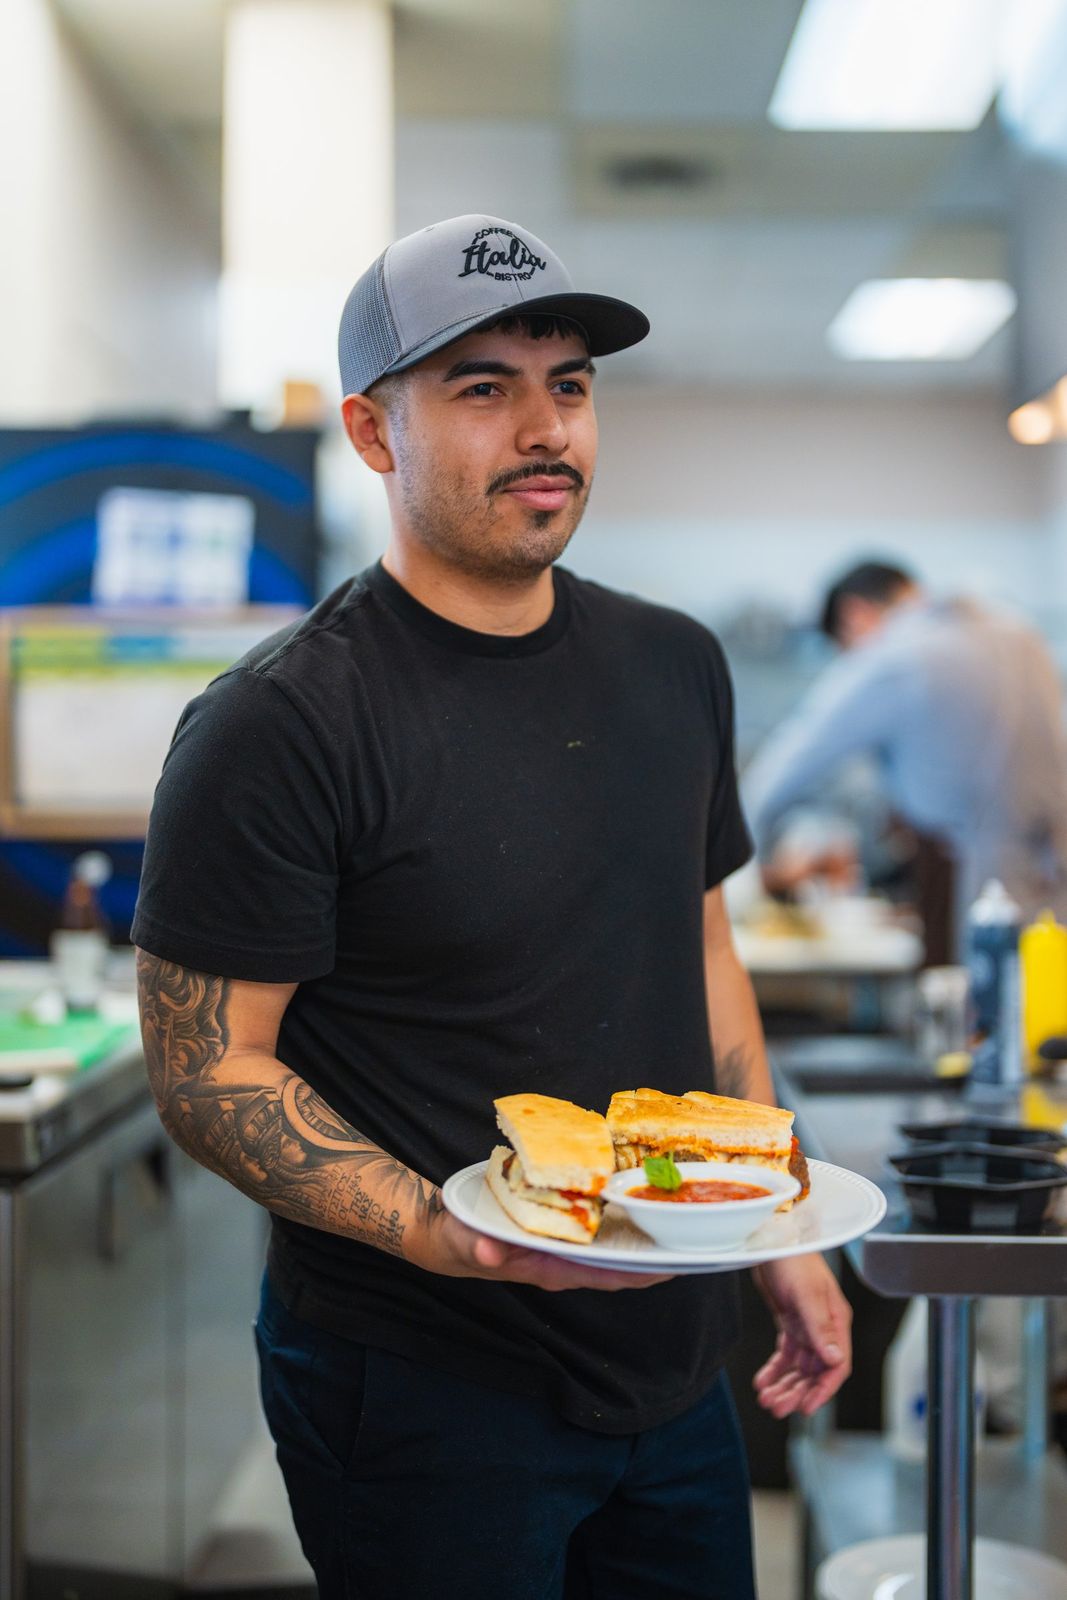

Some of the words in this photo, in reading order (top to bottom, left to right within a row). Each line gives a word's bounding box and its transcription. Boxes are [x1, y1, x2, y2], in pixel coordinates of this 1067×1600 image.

[475, 227, 513, 239] COFFEE
[458, 238, 547, 277] Italia
[494, 272, 531, 281] BISTRO
